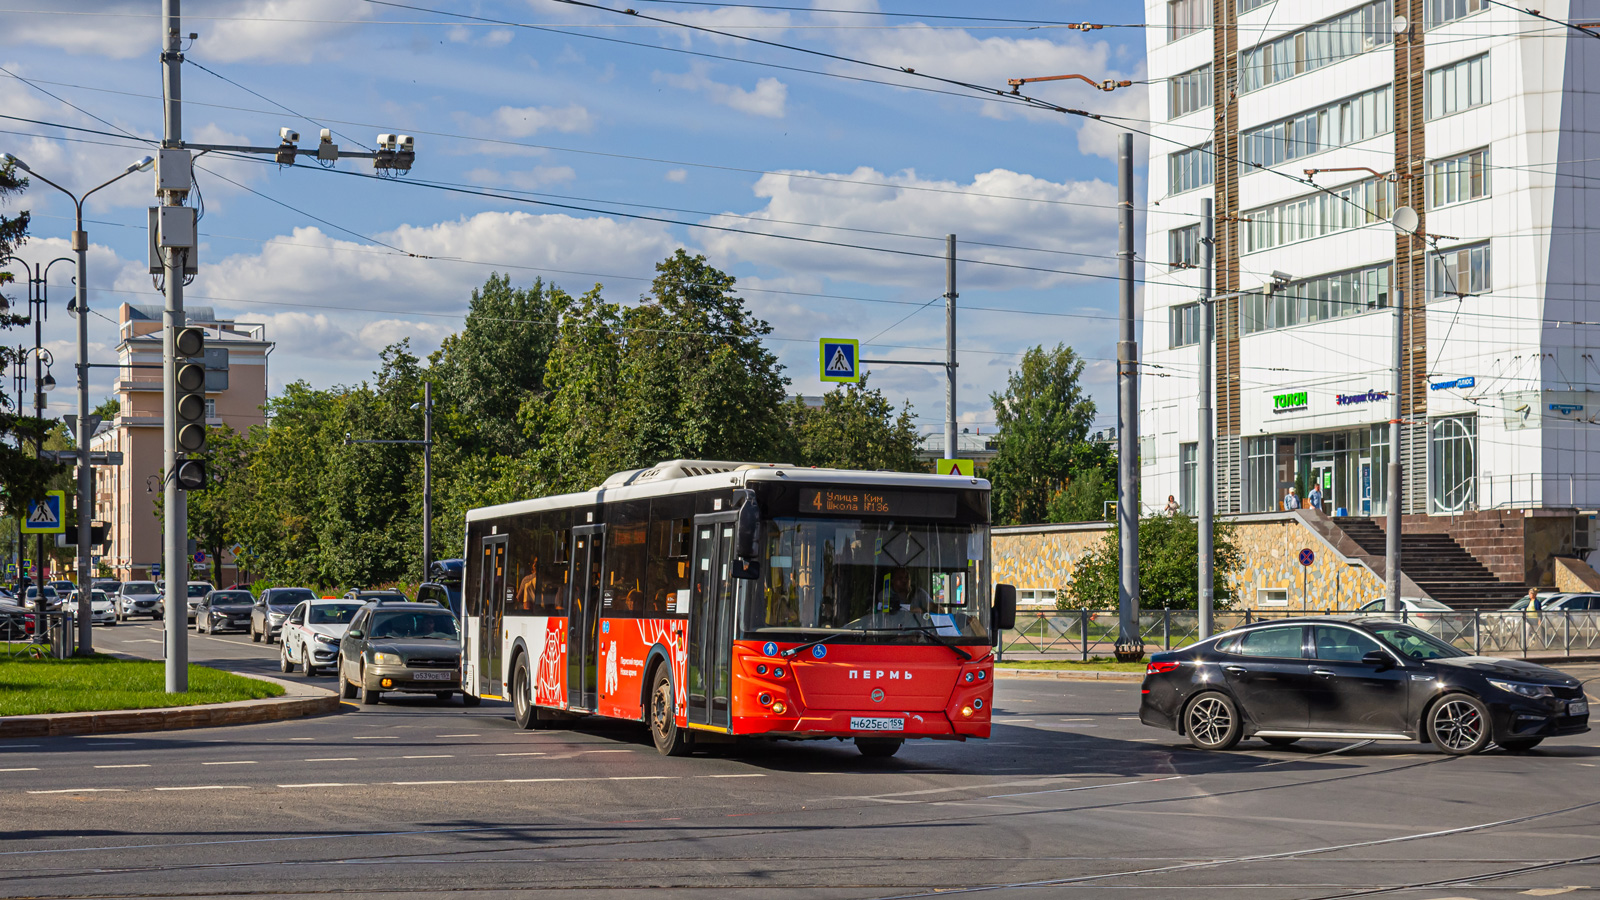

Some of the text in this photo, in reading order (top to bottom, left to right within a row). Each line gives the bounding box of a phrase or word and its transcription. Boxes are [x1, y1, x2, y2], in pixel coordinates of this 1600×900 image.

[812, 491, 823, 511] 4
[826, 491, 884, 503] Улица Ким
[826, 500, 859, 511] Школа
[849, 670, 913, 680] ПЕРМЬ
